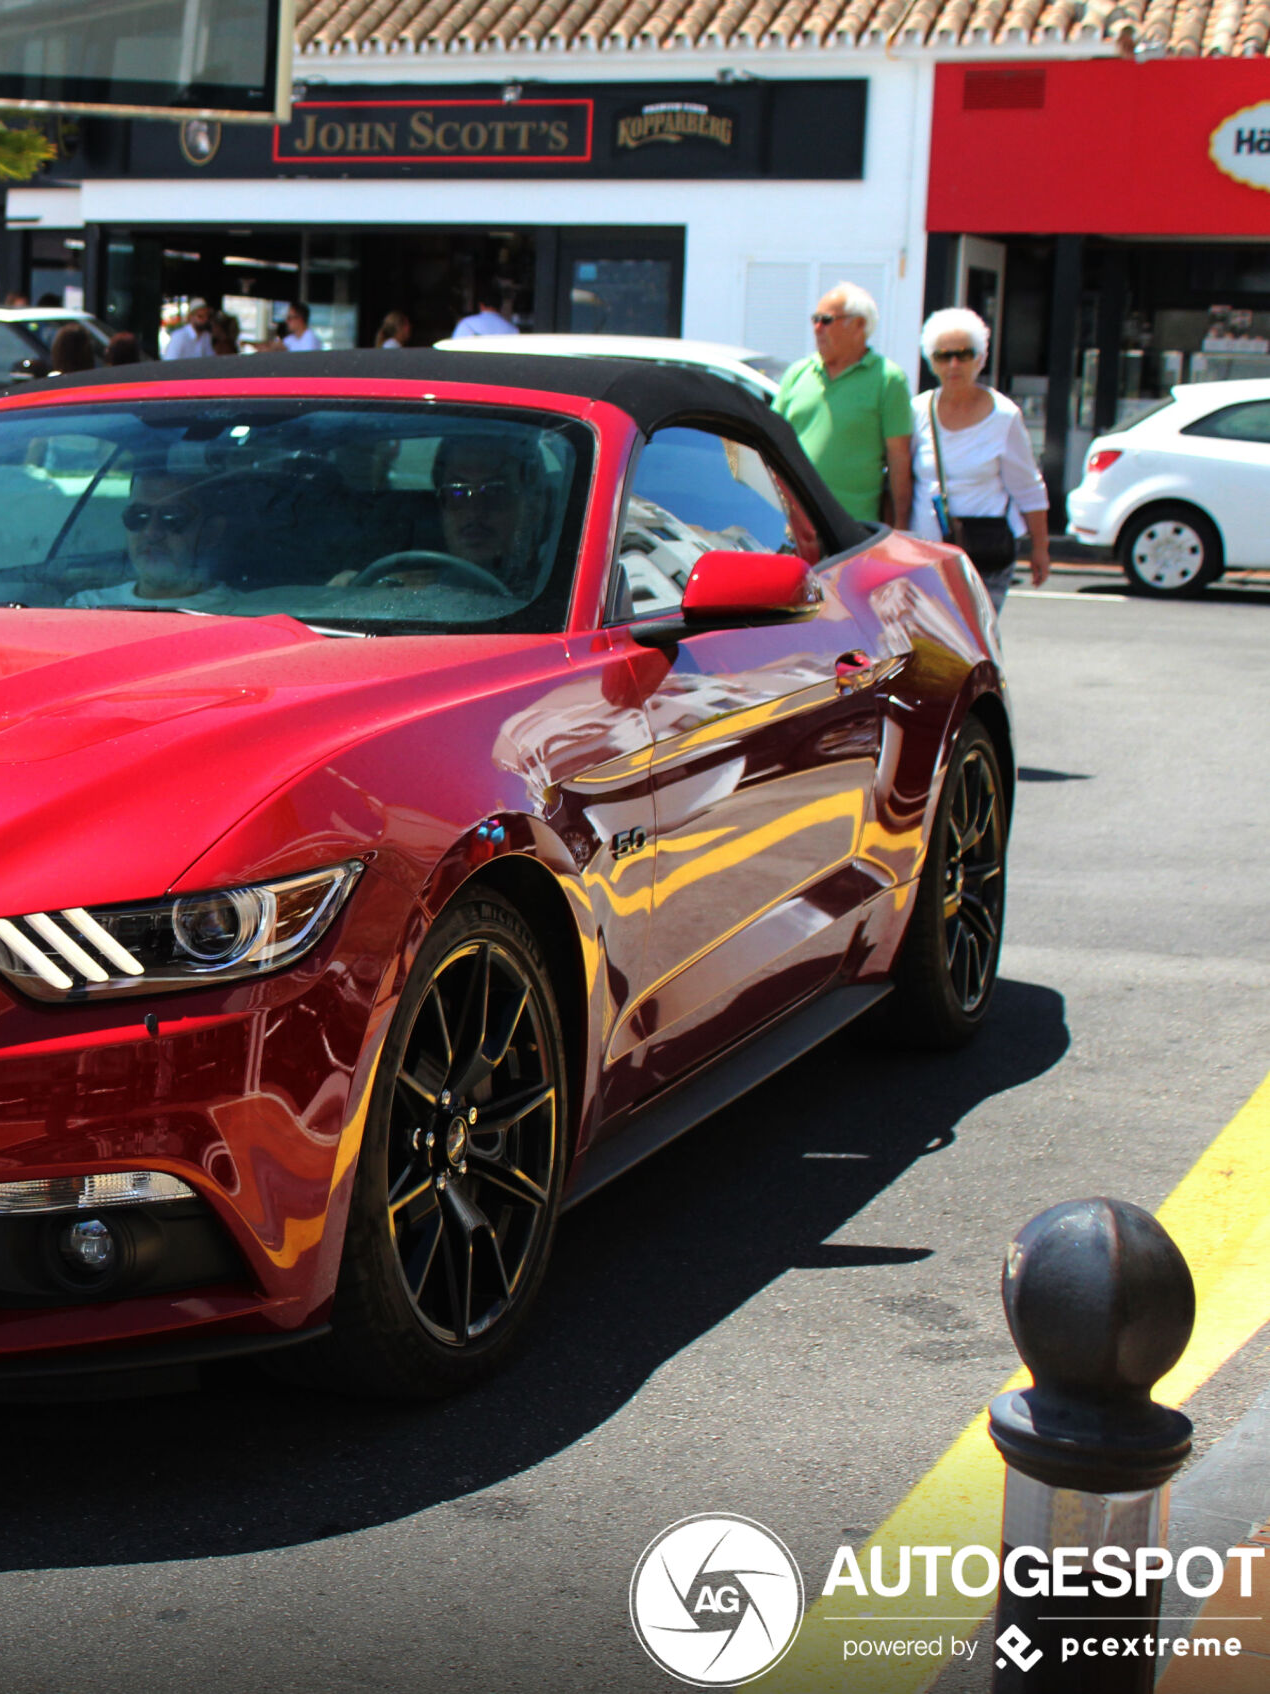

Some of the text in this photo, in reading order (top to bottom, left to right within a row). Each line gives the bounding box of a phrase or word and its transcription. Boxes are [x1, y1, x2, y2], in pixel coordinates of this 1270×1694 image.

[294, 111, 569, 151] JOHN SCOTT'S
[617, 111, 733, 148] KOPPARBERG
